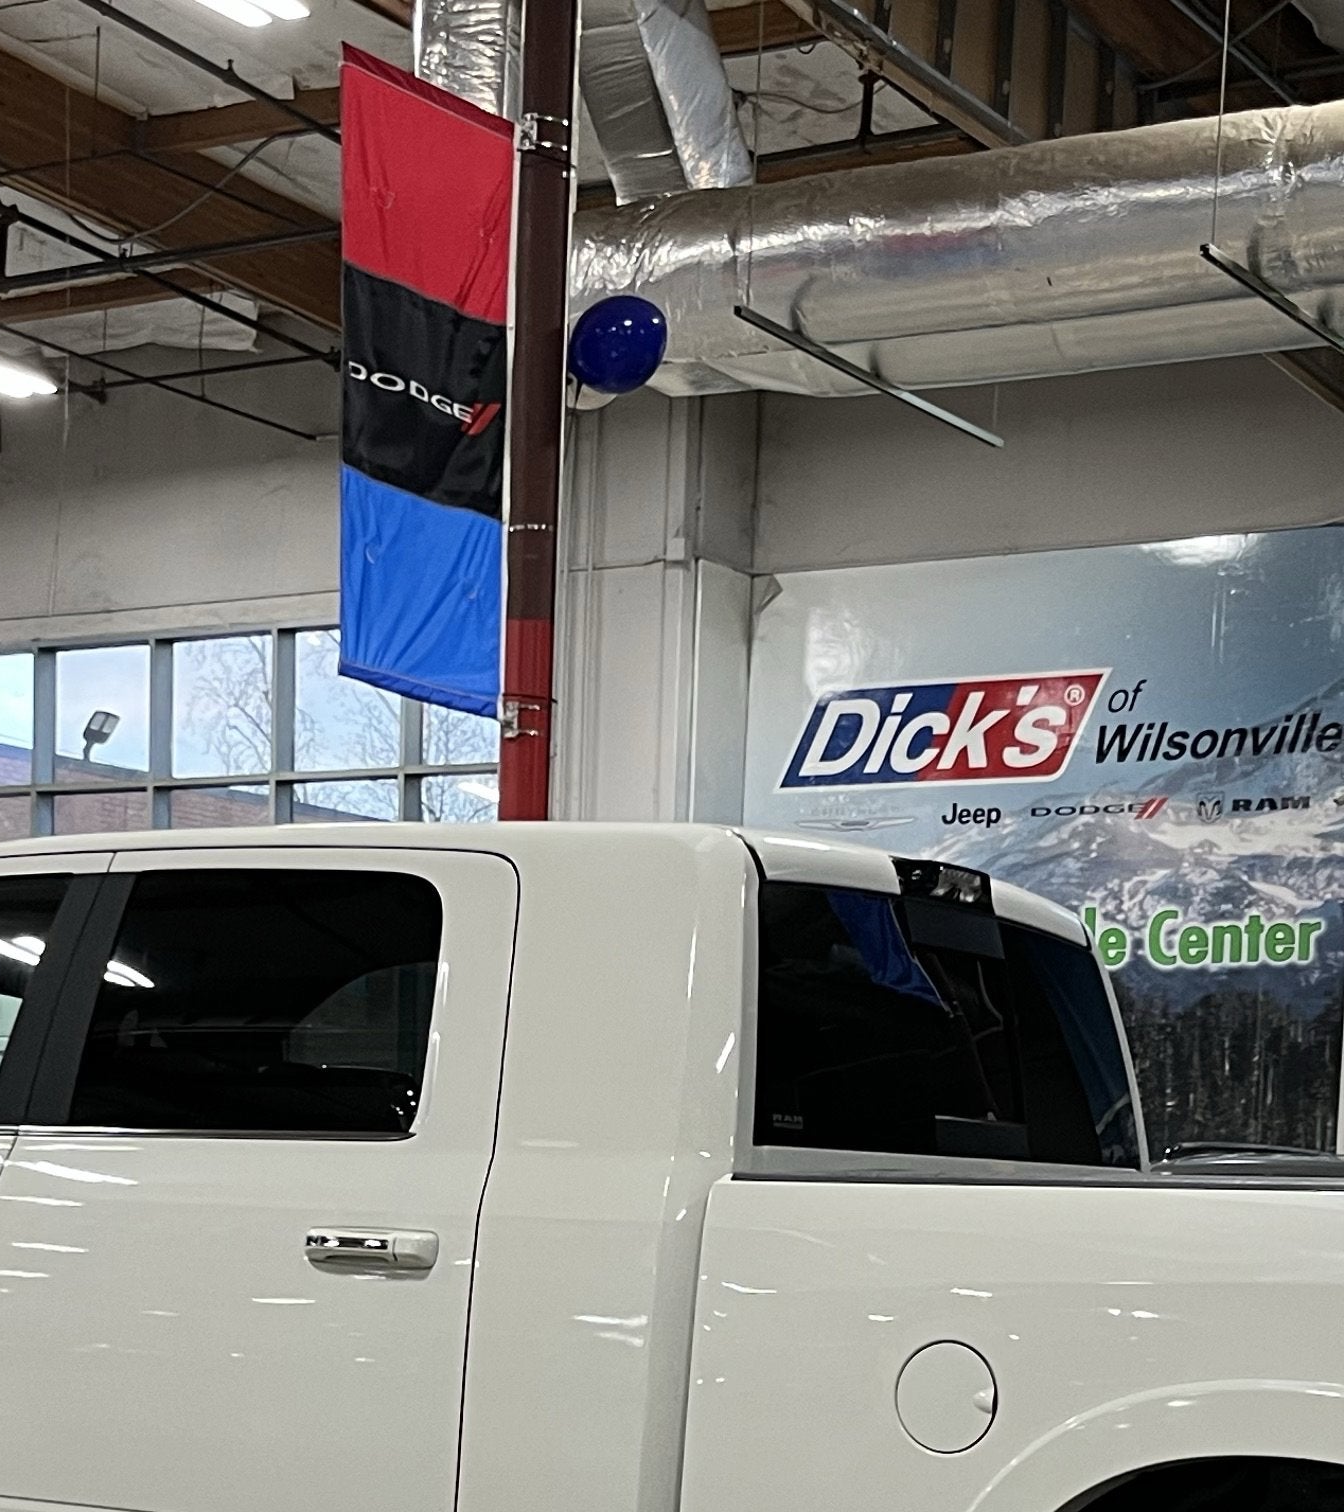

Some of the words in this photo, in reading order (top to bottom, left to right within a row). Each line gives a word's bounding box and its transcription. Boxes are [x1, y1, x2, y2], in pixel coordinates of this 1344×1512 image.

[348, 361, 475, 424] DODGE
[1107, 679, 1148, 714] of
[797, 685, 1067, 777] Dick's
[1094, 708, 1344, 765] Wilsonville
[941, 803, 1002, 828] Jeep
[1030, 802, 1144, 818] DODGE
[1231, 796, 1311, 813] RAM
[1148, 909, 1322, 965] Center
